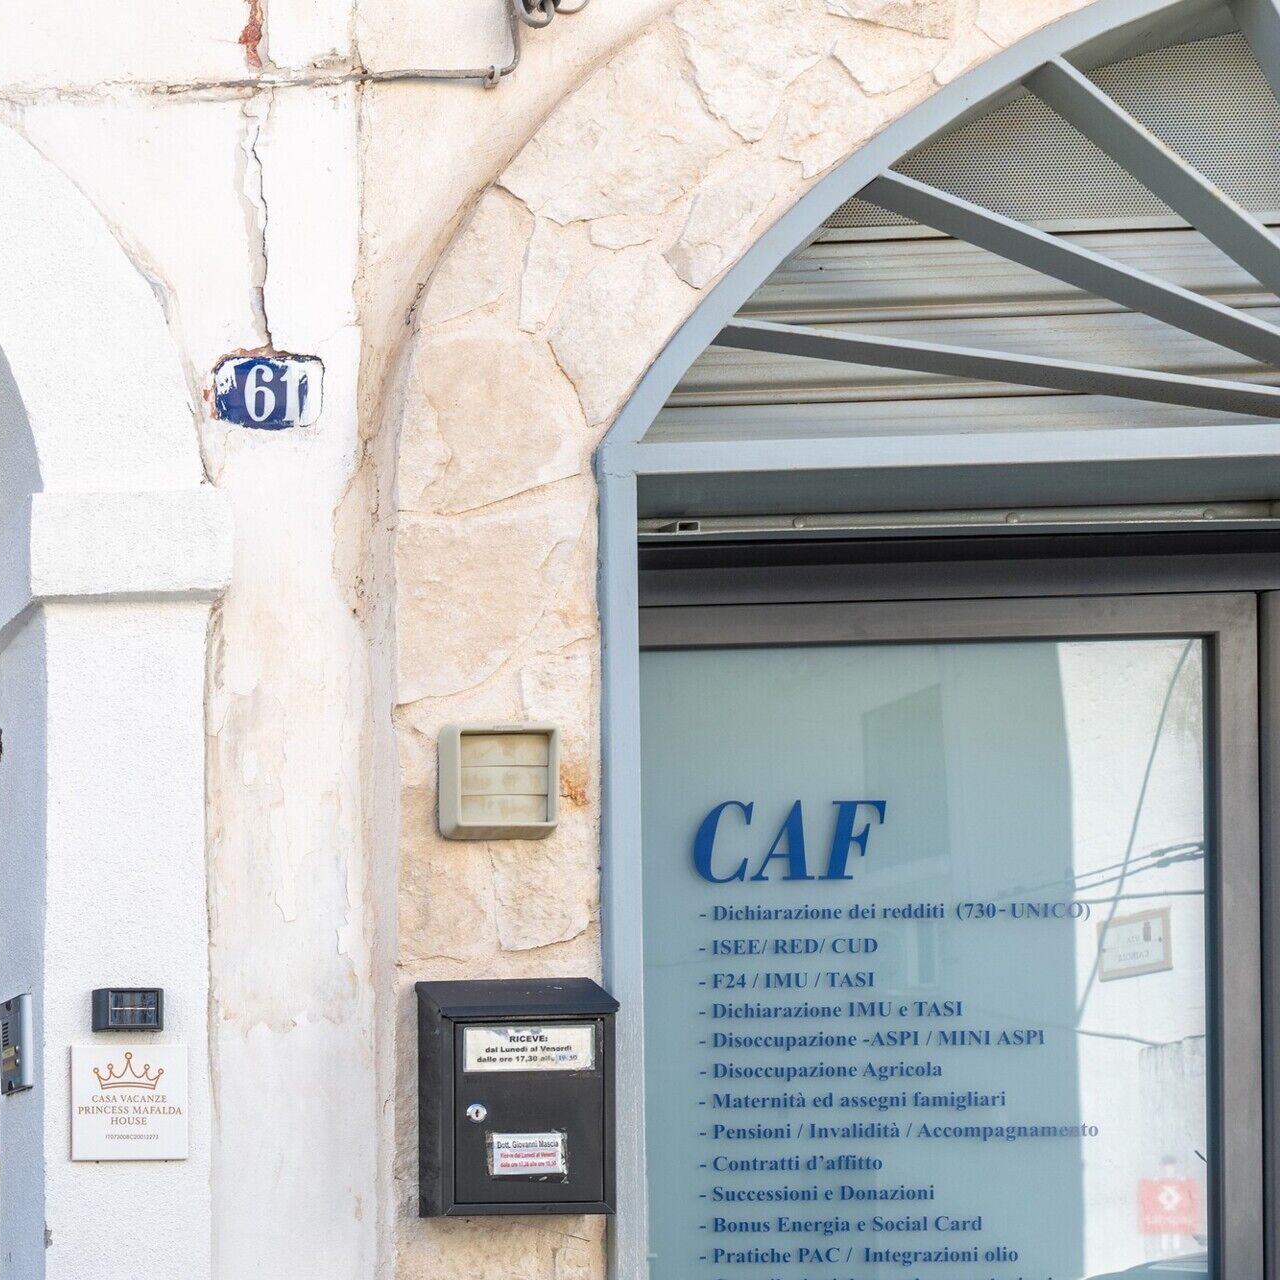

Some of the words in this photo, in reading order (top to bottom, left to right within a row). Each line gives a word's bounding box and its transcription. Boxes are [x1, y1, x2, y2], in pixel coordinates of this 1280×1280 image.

[244, 364, 301, 423] 61
[692, 799, 887, 884] CAF
[711, 904, 842, 920] Dichiarazione
[847, 904, 876, 919] dei
[881, 903, 944, 919] redditi
[830, 938, 878, 954] CUD
[711, 974, 746, 989] F24
[764, 973, 807, 988] IMU
[826, 972, 874, 987] TASI
[711, 1003, 842, 1018] Dichiarazione
[848, 1002, 892, 1017] IMU
[897, 1006, 908, 1017] e
[914, 1001, 963, 1016] TASI
[711, 1032, 857, 1051] Disoccupazione
[937, 1030, 990, 1046] MINI
[997, 1030, 1045, 1046] ASPI
[712, 1062, 857, 1082] Disoccupazione
[862, 1062, 943, 1081] Agricola
[92, 1095, 117, 1103] CASA
[121, 1095, 167, 1103] VACANZE
[712, 1092, 806, 1109] Maternità
[810, 1092, 833, 1108] ed
[839, 1092, 906, 1111] assegni
[912, 1091, 1006, 1111] famigliari
[78, 1106, 129, 1114] PRINCESS
[132, 1106, 182, 1114] MAFALDA
[110, 1117, 147, 1125] HOUSE
[712, 1124, 791, 1140] Pensioni
[809, 1123, 900, 1139] Invalidità
[917, 1122, 1098, 1142] Accompagnamento
[712, 1156, 799, 1171] Contratti
[712, 1186, 818, 1202] Successioni
[824, 1190, 833, 1201] e
[839, 1185, 934, 1200] Donazioni
[712, 1218, 770, 1232] Bonus
[776, 1217, 850, 1236] Energia
[856, 1221, 866, 1232] e
[871, 1216, 927, 1231] Social
[934, 1216, 982, 1231] Card
[712, 1248, 791, 1264] Pratiche
[797, 1248, 840, 1264] PAC
[864, 1247, 978, 1267] Integrazioni
[984, 1247, 1018, 1263] olio
